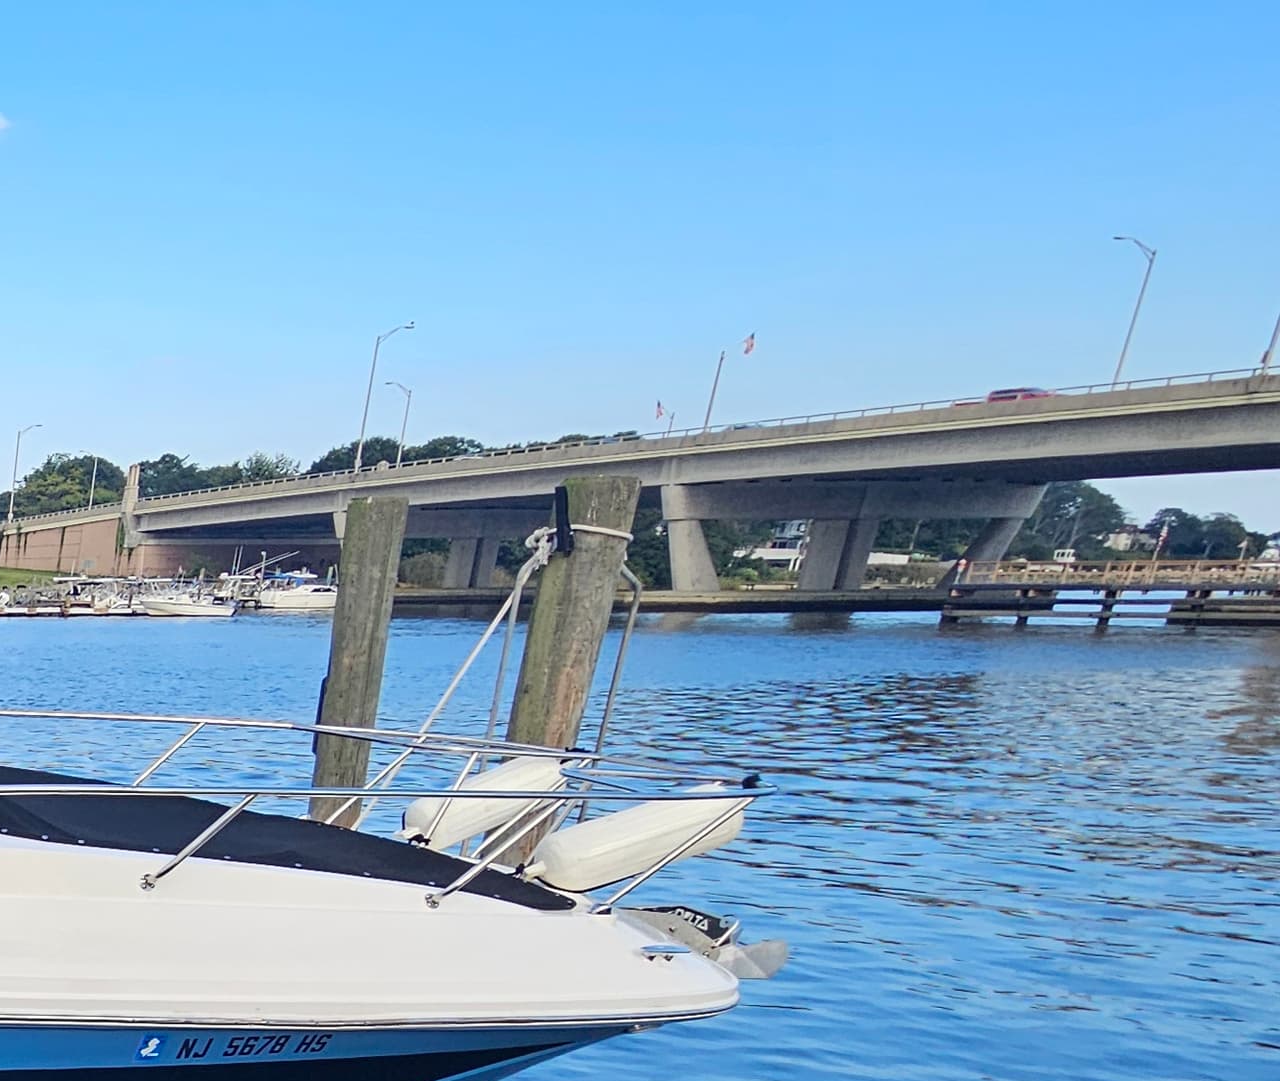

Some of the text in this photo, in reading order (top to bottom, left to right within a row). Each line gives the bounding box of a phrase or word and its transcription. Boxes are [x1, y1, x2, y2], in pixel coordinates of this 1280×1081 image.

[176, 1034, 333, 1059] NJ 5678 HS
